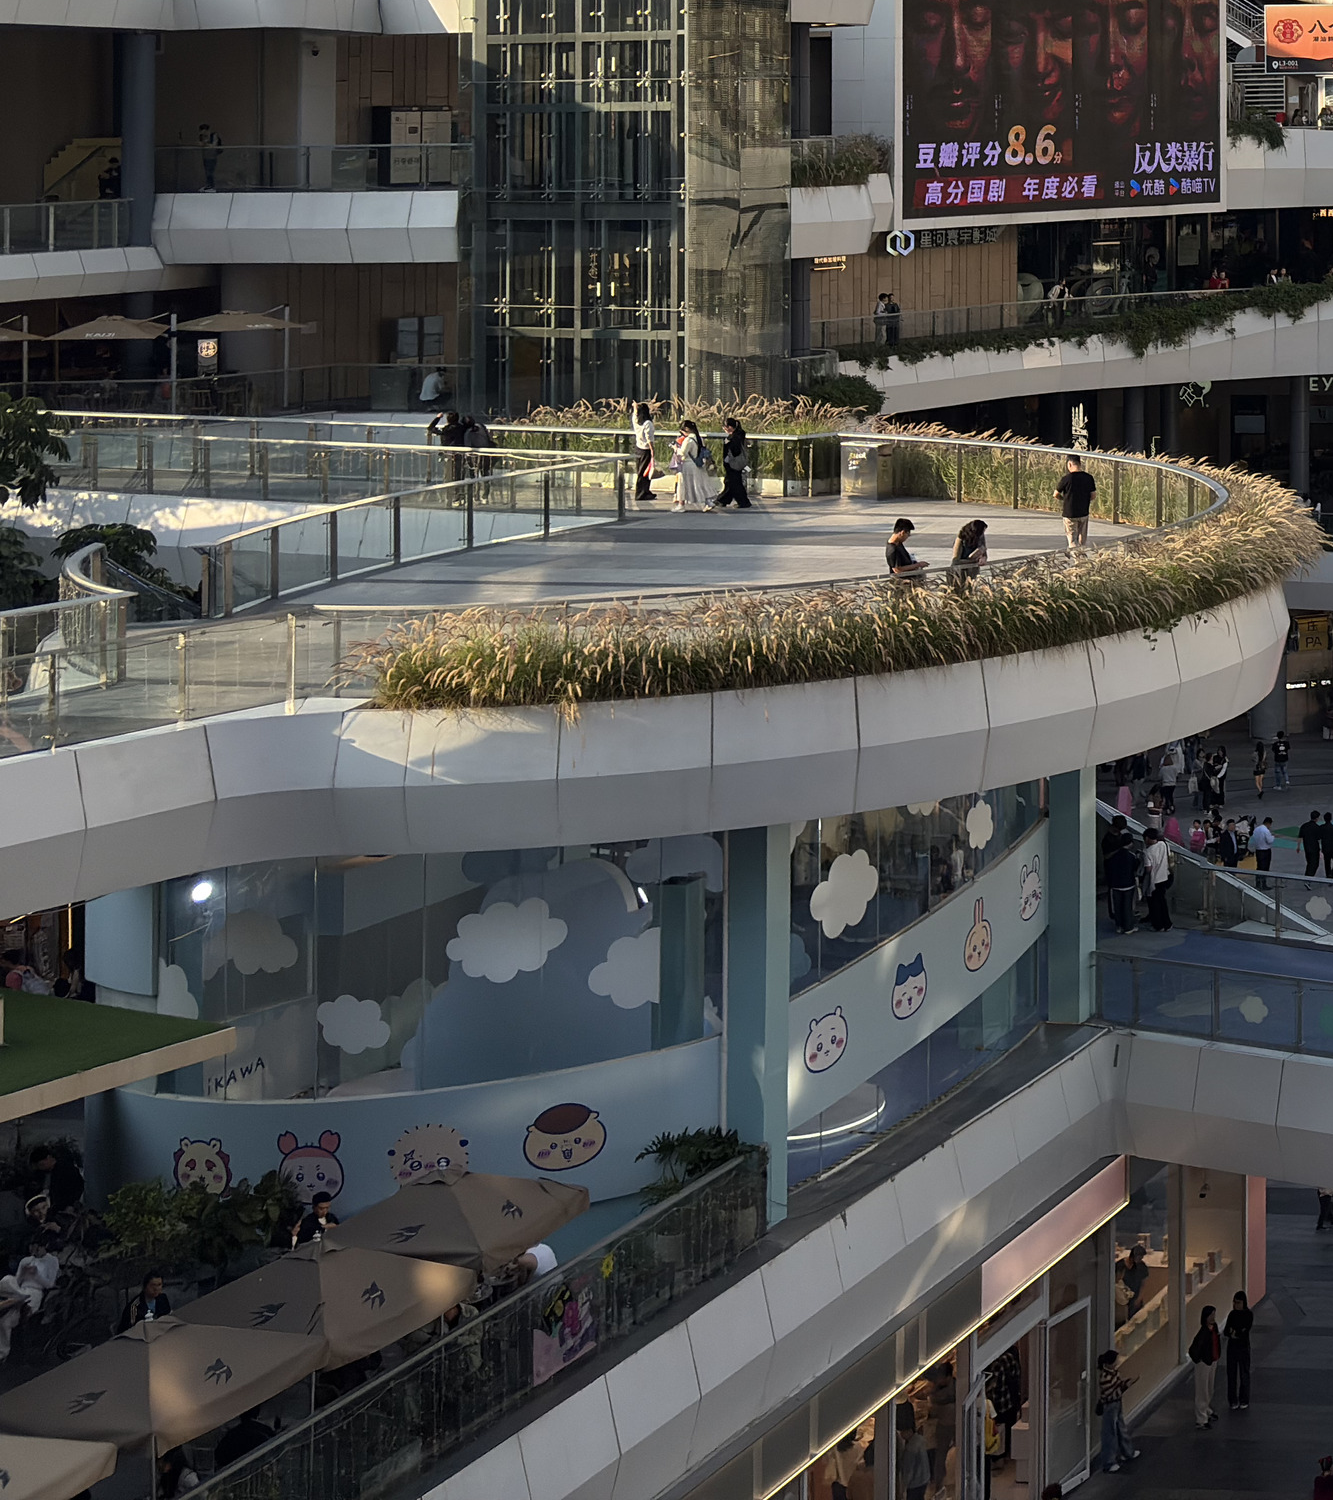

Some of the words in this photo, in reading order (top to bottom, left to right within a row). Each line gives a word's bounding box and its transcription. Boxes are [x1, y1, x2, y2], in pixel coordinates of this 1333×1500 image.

[915, 141, 1002, 169] 豆瓣评分
[1133, 141, 1215, 175] 反人类暴行
[924, 179, 1006, 206] 高分国剧
[1022, 174, 1098, 200] 年度必看
[1142, 179, 1165, 196] 优酷
